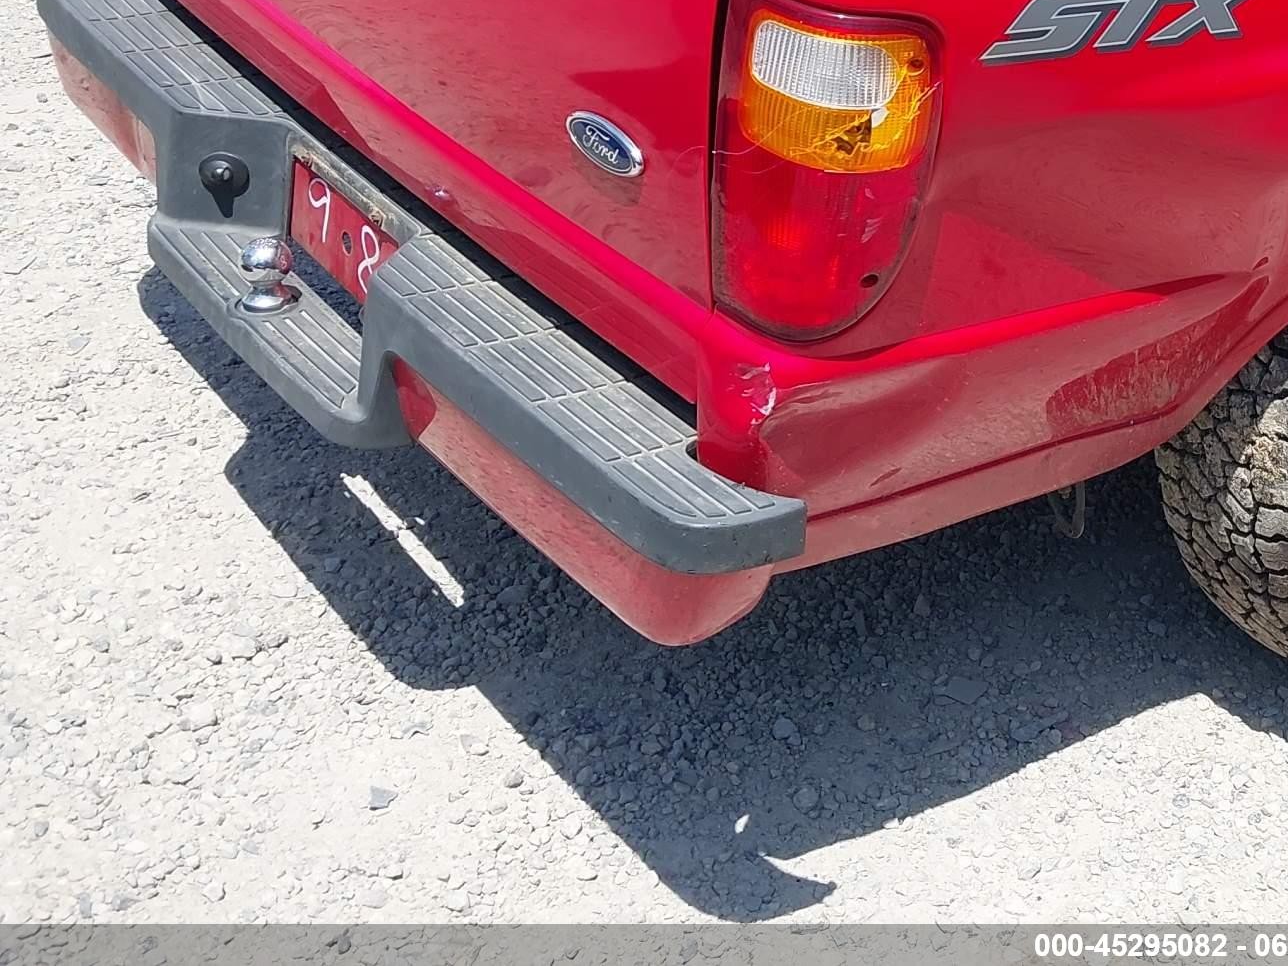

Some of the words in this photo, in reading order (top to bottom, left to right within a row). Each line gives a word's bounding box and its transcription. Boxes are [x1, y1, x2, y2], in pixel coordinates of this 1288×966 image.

[582, 125, 619, 164] Ford
[308, 177, 331, 243] 9
[357, 224, 380, 295] 8
